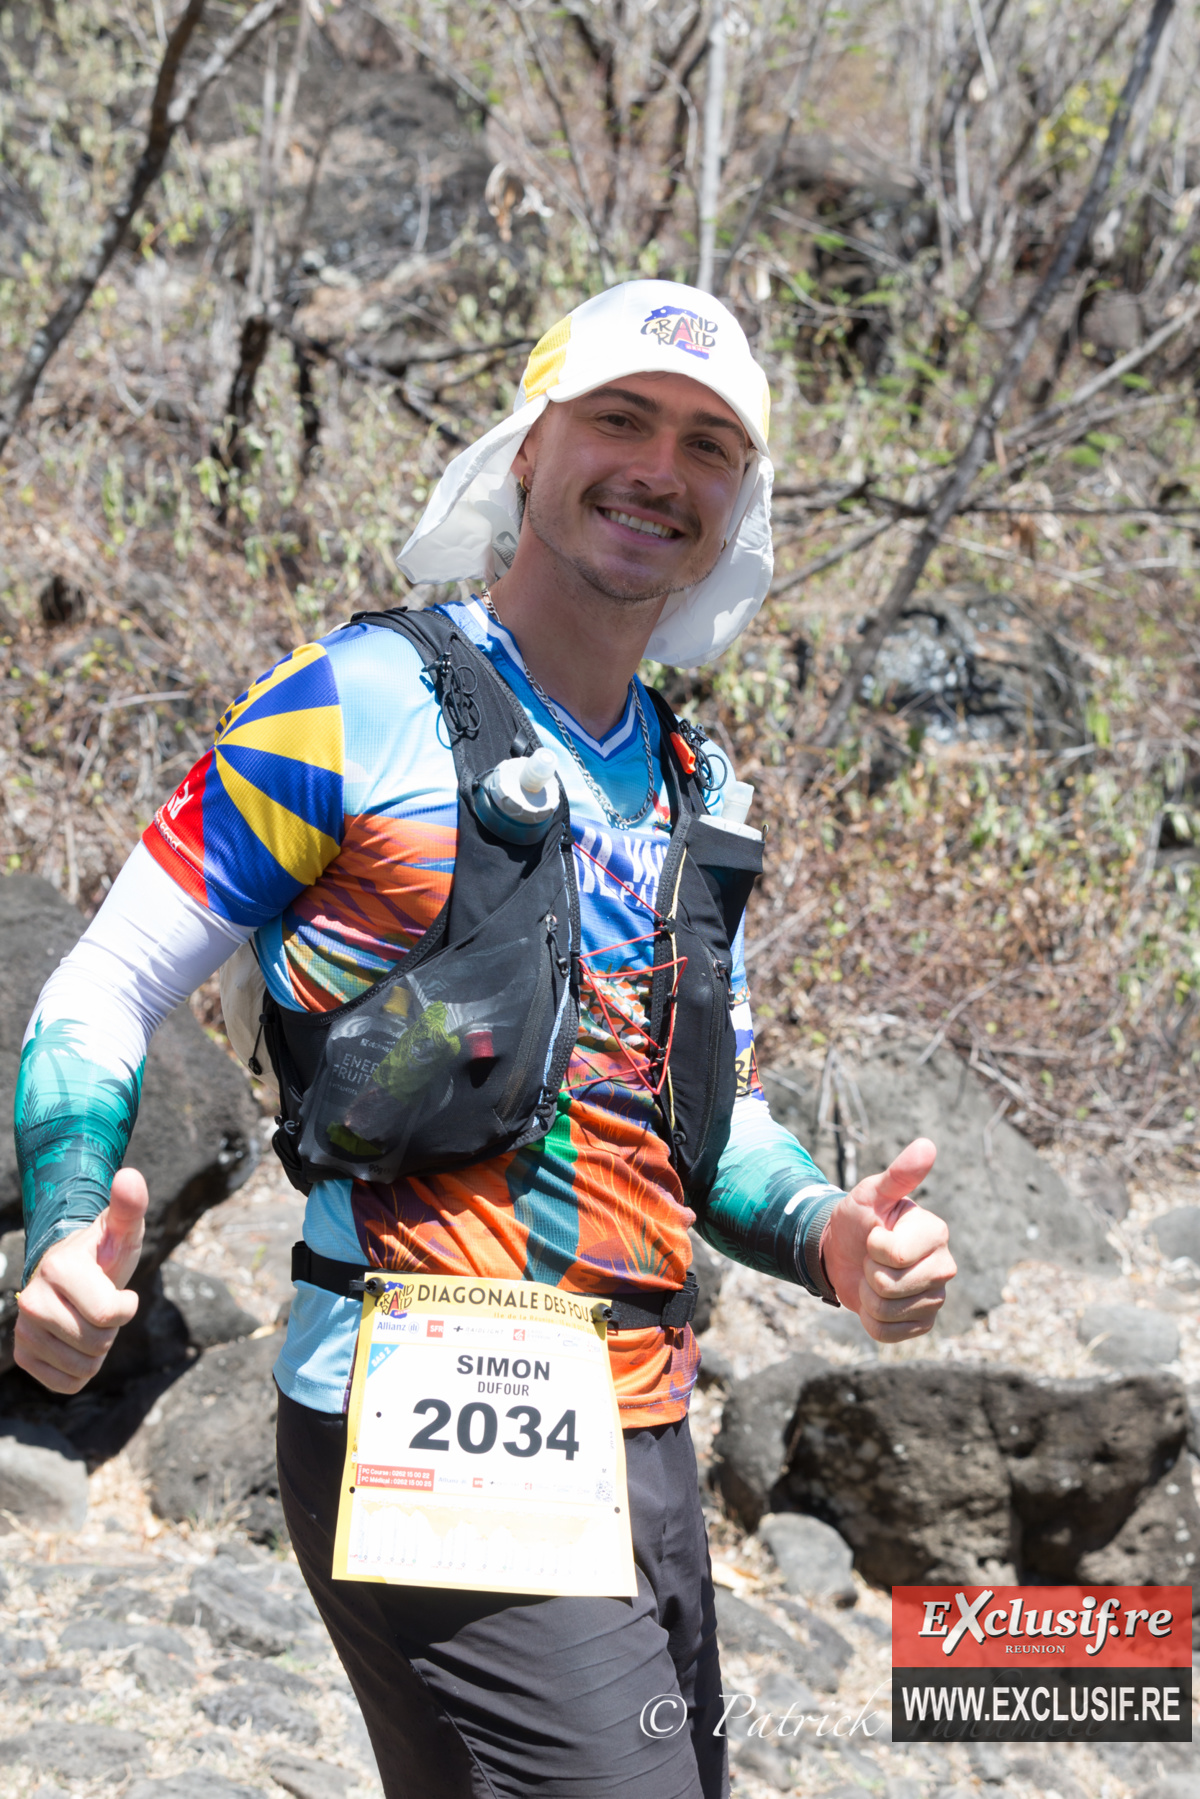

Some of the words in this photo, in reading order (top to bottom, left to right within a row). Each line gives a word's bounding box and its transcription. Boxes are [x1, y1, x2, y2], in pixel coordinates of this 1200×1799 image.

[640, 316, 718, 337] GRAND
[657, 328, 716, 348] RAID
[417, 1284, 538, 1310] DIAGONALE
[544, 1293, 566, 1315] DES
[567, 1301, 592, 1323] FOU
[376, 1321, 406, 1331] Allianz
[429, 1325, 444, 1333] SFR
[456, 1354, 550, 1381] SIMON
[477, 1381, 530, 1397] DUFOUR
[408, 1398, 579, 1461] 2034
[370, 1468, 389, 1476] Course
[369, 1476, 390, 1484] Médical
[415, 1479, 423, 1487] 00
